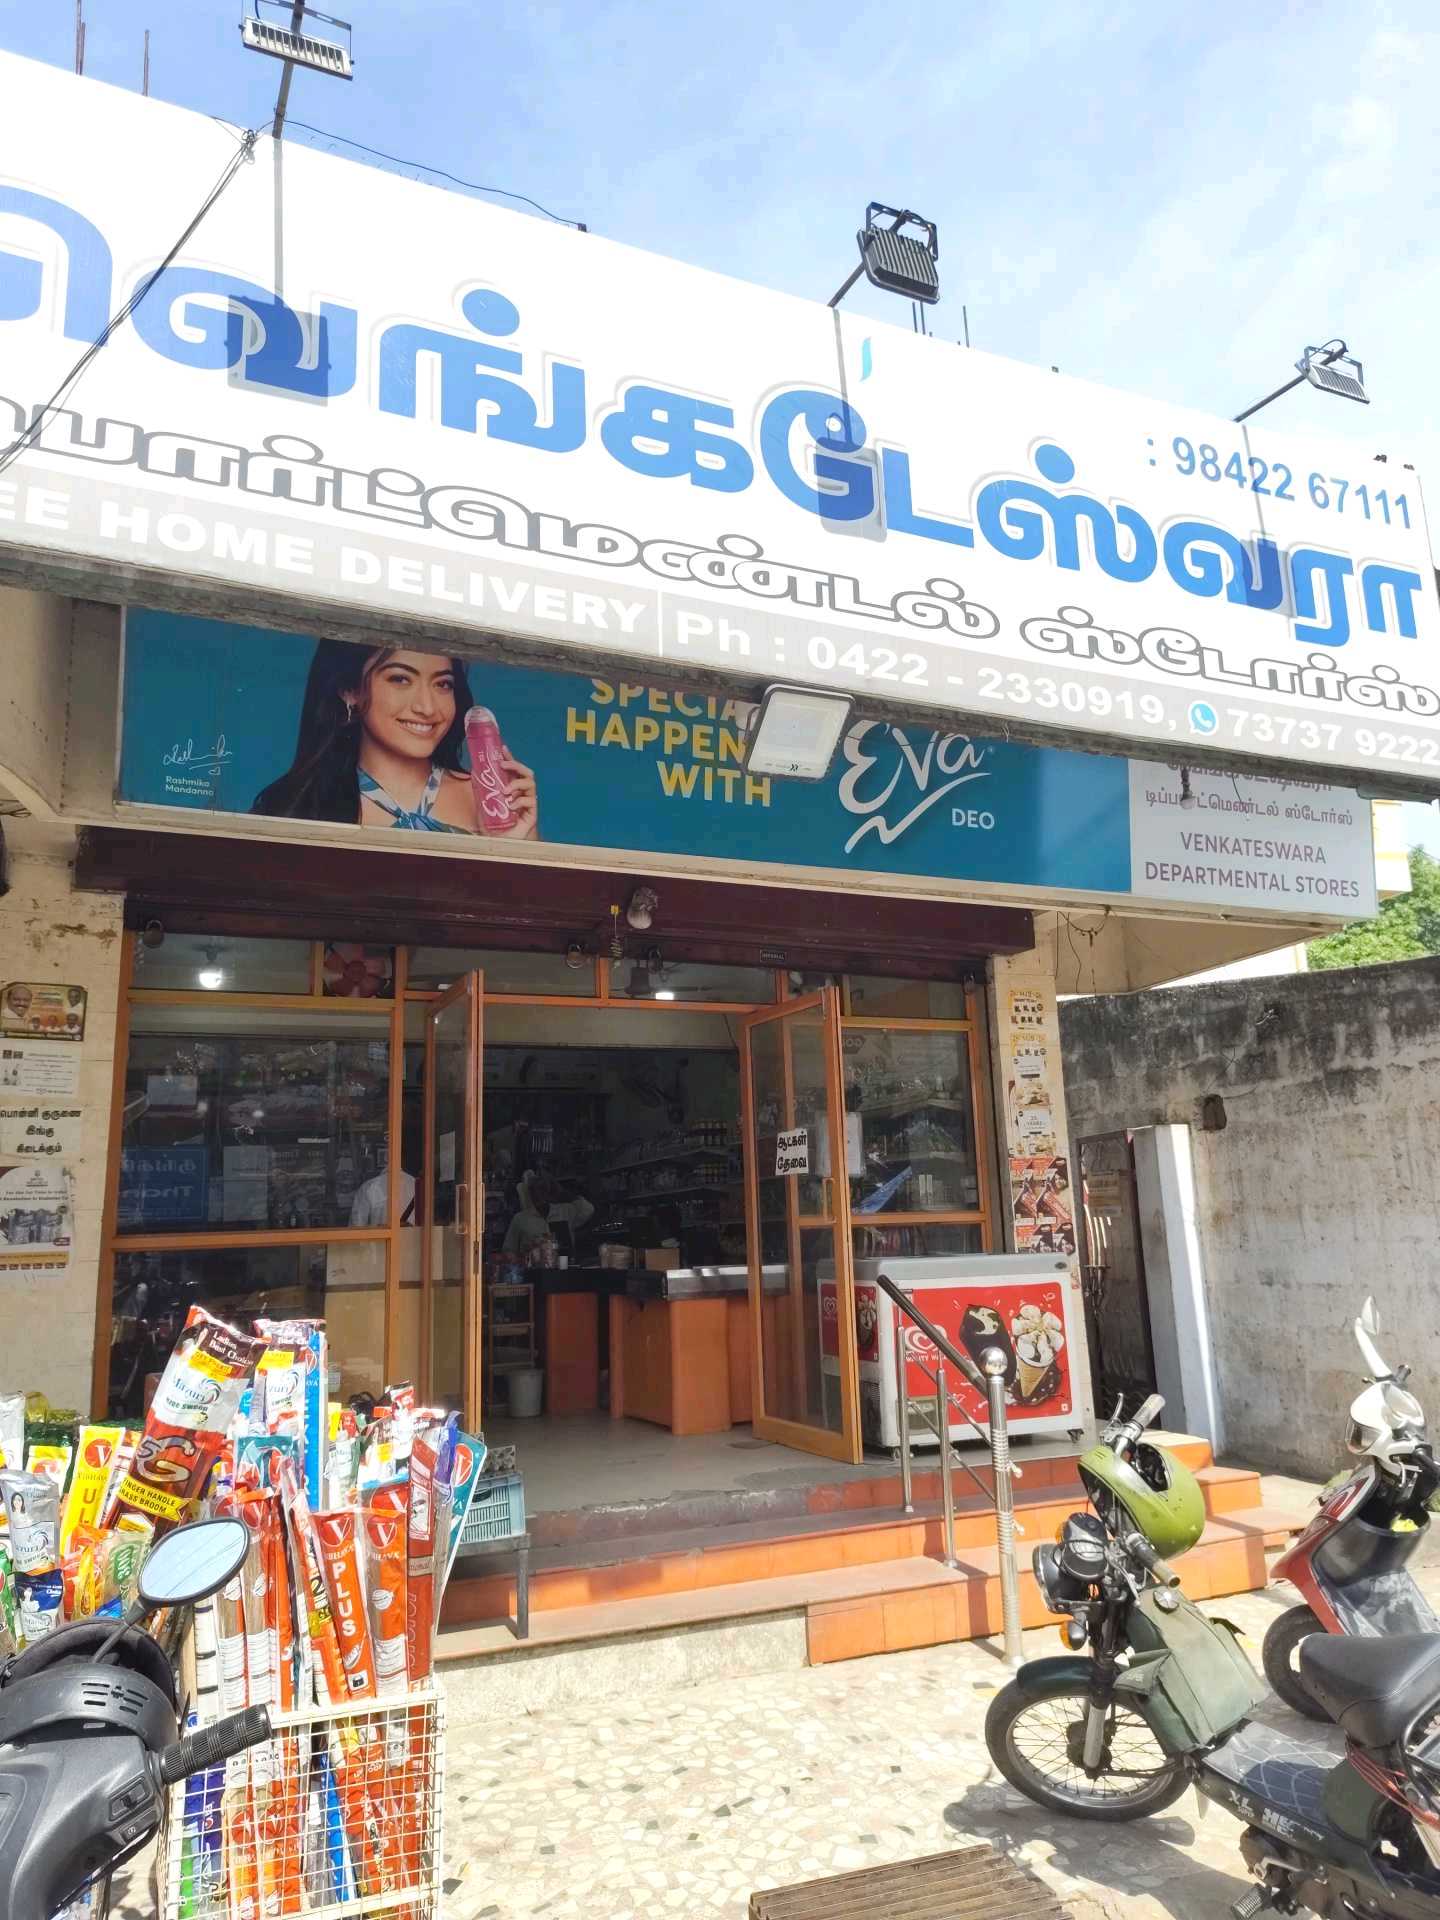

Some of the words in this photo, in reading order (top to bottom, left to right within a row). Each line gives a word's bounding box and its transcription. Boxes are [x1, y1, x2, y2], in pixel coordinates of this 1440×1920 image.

[1172, 436, 1295, 502] 98422
[1308, 472, 1411, 530] 67111
[0, 396, 1000, 640] பார்ட்மெண்டல்
[1019, 605, 1440, 717] ஸ்டோர்ஸ்
[100, 500, 315, 577] HOME
[341, 546, 649, 633] DELIVERY
[675, 609, 752, 657] Ph
[806, 636, 930, 687] 0422
[977, 666, 1177, 731] 2330919,
[1226, 708, 1344, 753] 73737
[165, 775, 211, 787] Rashmika
[165, 784, 215, 796] Mandanna
[656, 760, 771, 807] WITH
[951, 807, 996, 830] DEO
[1285, 803, 1353, 826] ஸ்டோர்ஸ்
[1180, 831, 1327, 864] VENKATESWARA
[1145, 861, 1290, 892] DEPARTMENTAL
[1295, 875, 1360, 898] STORES
[26, 1125, 55, 1138] இங்கு
[777, 1130, 807, 1151] ஆட்கள்
[16, 1142, 63, 1155] கிடைக்கும்
[777, 1156, 808, 1172] தேவை
[139, 1498, 168, 1514] BROOM
[148, 1490, 177, 1507] HANDLE
[332, 1561, 357, 1637] PLUS
